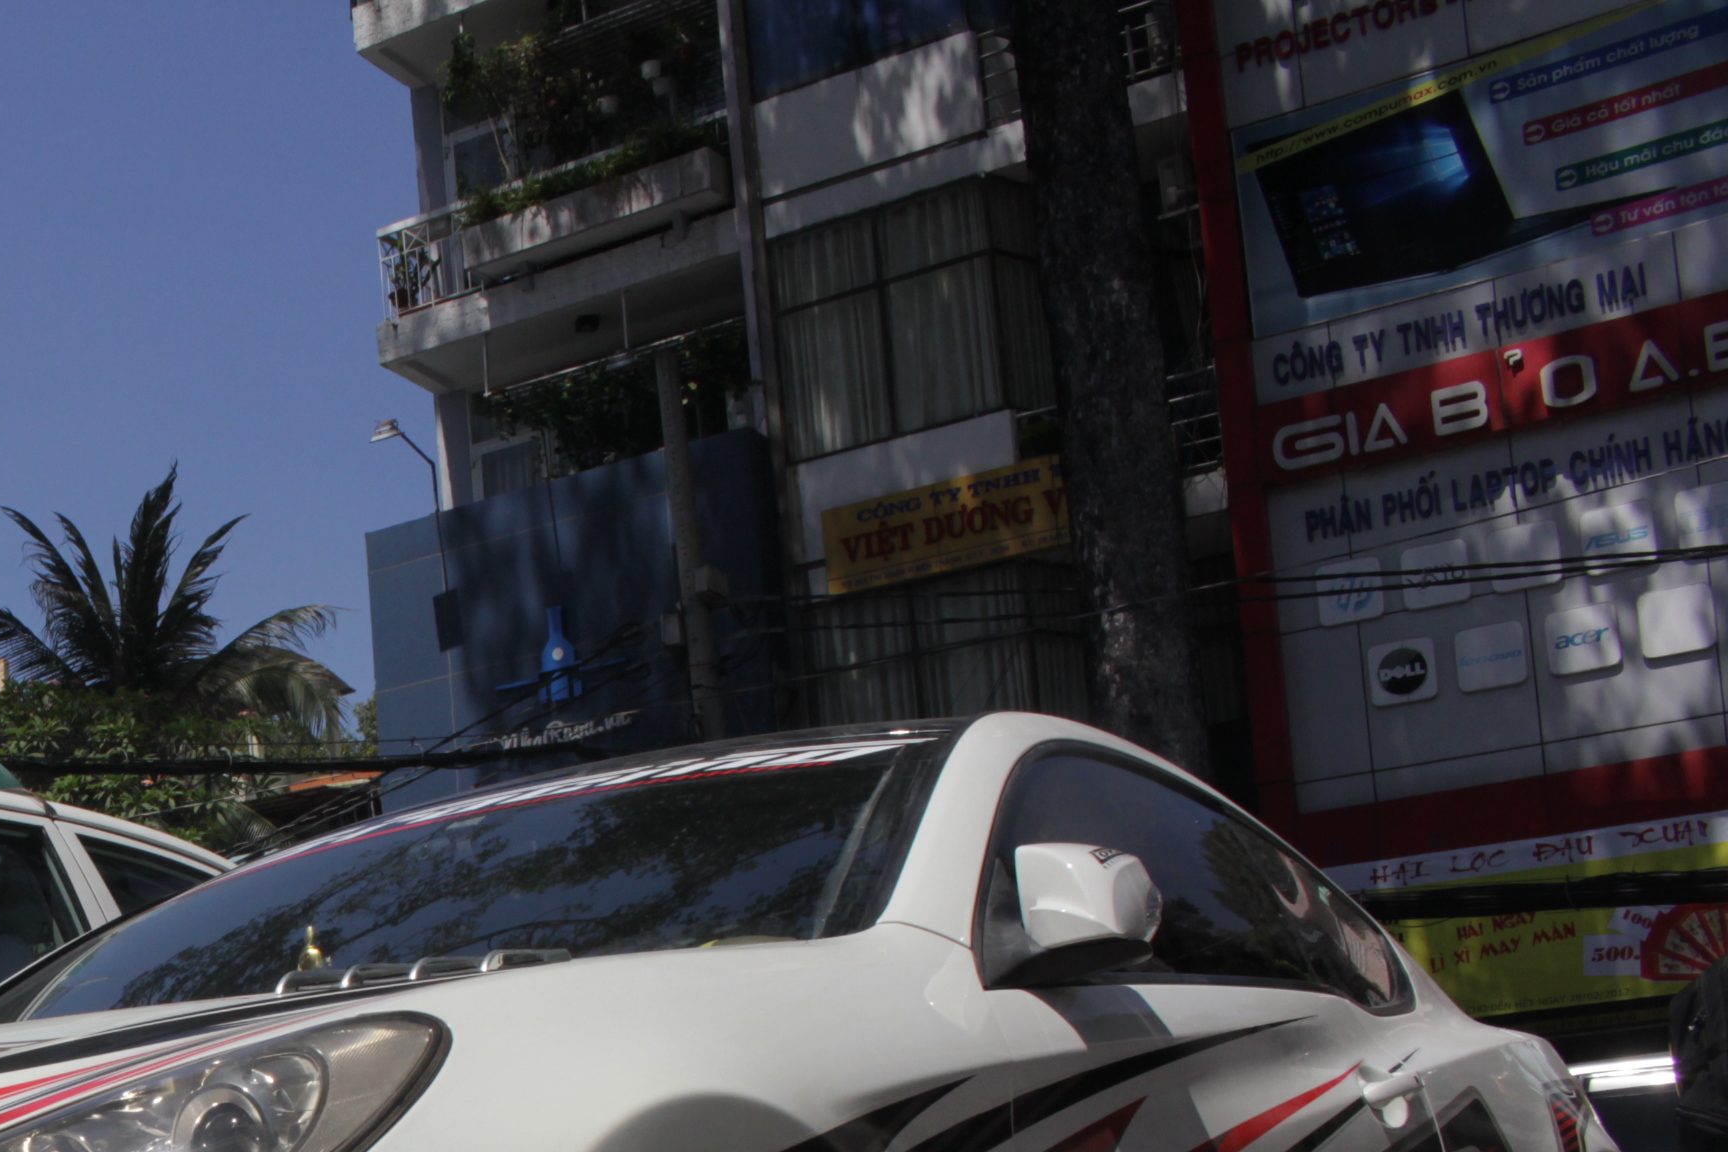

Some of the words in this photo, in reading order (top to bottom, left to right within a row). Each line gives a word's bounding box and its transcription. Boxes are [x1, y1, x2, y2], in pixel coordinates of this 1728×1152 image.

[1273, 340, 1344, 387] CÔNG
[1351, 330, 1386, 368] TY
[1396, 308, 1468, 355] TNHH
[1474, 279, 1586, 340] THƯƠNG
[1595, 262, 1648, 316] MẠI
[1272, 401, 1409, 471] GIA
[856, 496, 922, 524] CÔNG
[928, 486, 962, 506] TY
[967, 467, 1042, 498] TNHH
[1304, 493, 1373, 542] PHÂN
[1381, 469, 1443, 529] PHỐI
[1451, 456, 1558, 514] LAPTOP
[1568, 433, 1654, 490] CHÍNH
[839, 518, 915, 563] VIỆT
[922, 495, 1035, 546] DƯƠNG
[1585, 524, 1649, 552] ASUS
[1555, 625, 1611, 651] acer
